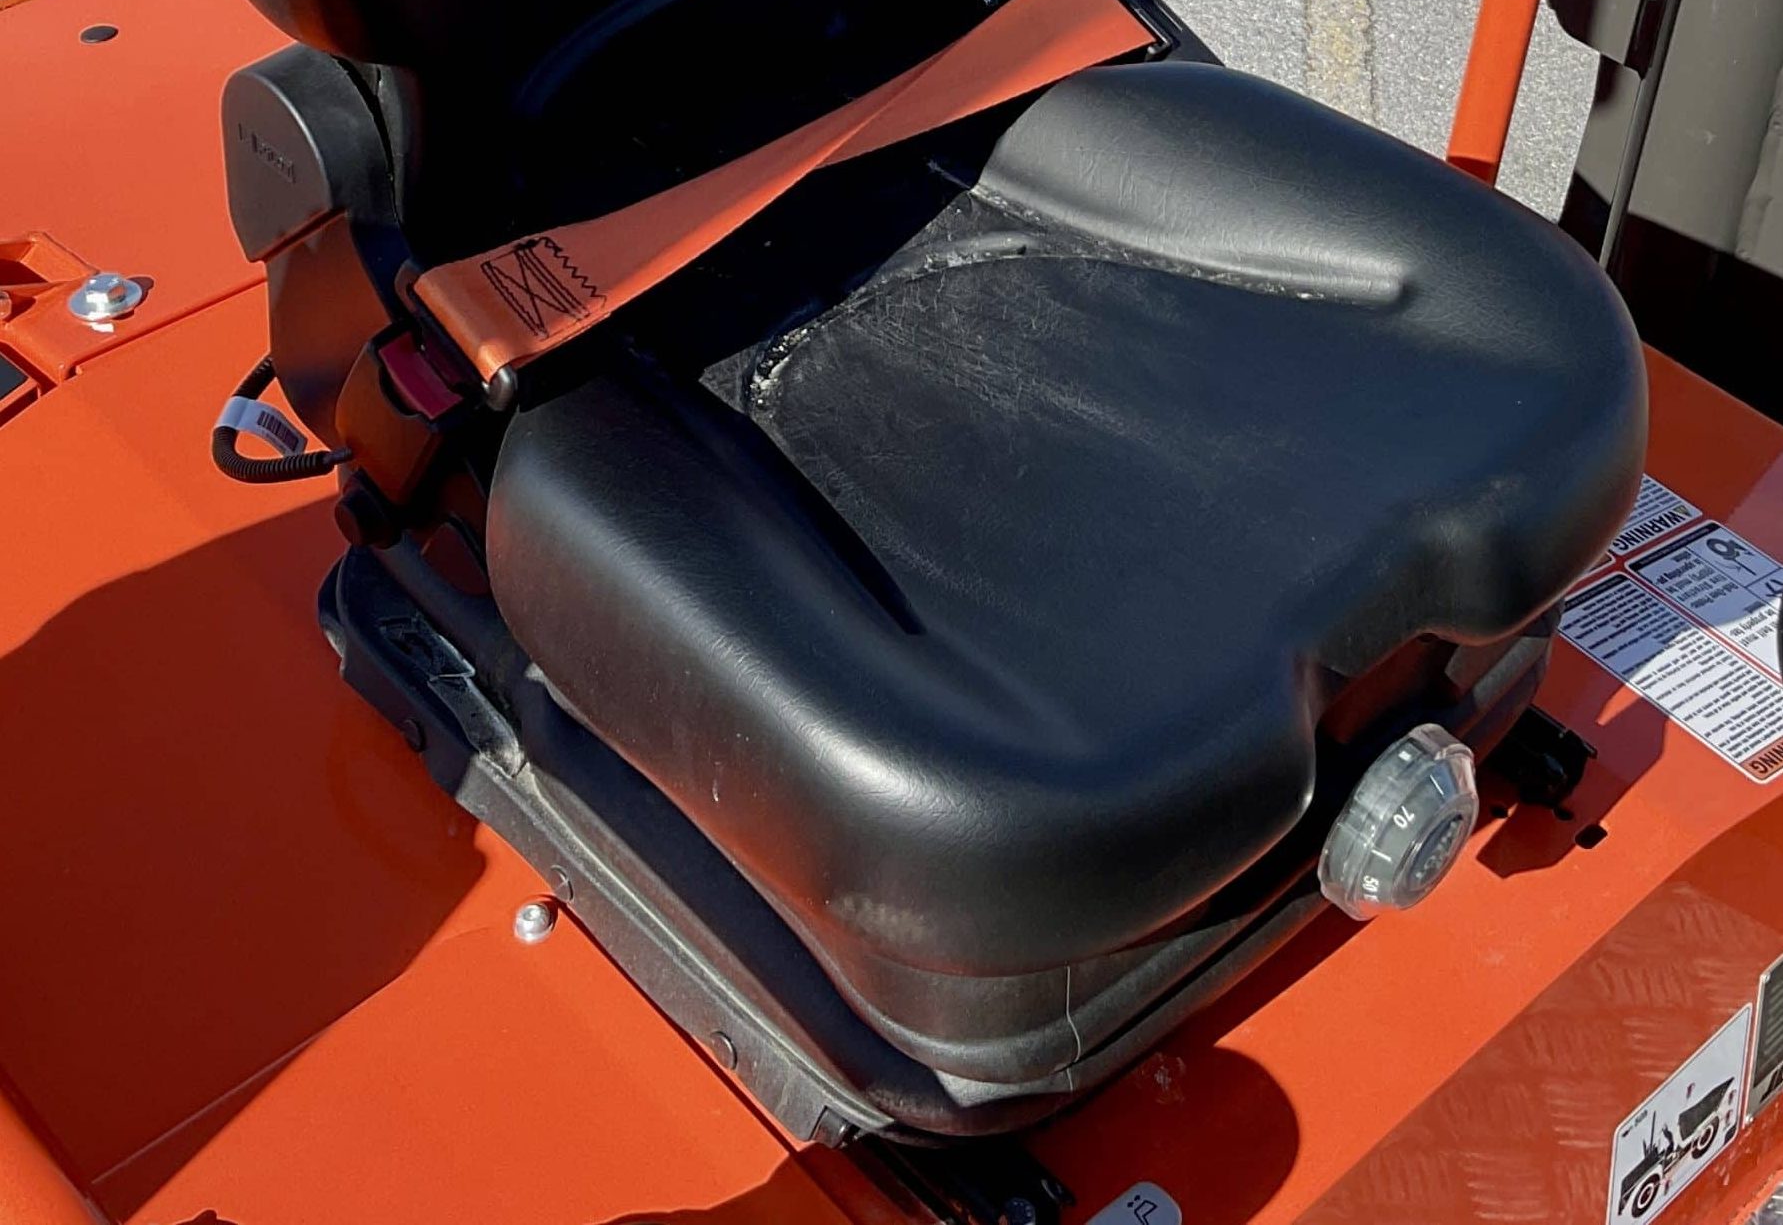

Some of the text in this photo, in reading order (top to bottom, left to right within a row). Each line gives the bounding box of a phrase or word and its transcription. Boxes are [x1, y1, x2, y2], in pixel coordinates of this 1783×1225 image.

[1612, 511, 1686, 551] WARNING
[1749, 742, 1783, 773] NING
[1393, 805, 1414, 828] 70
